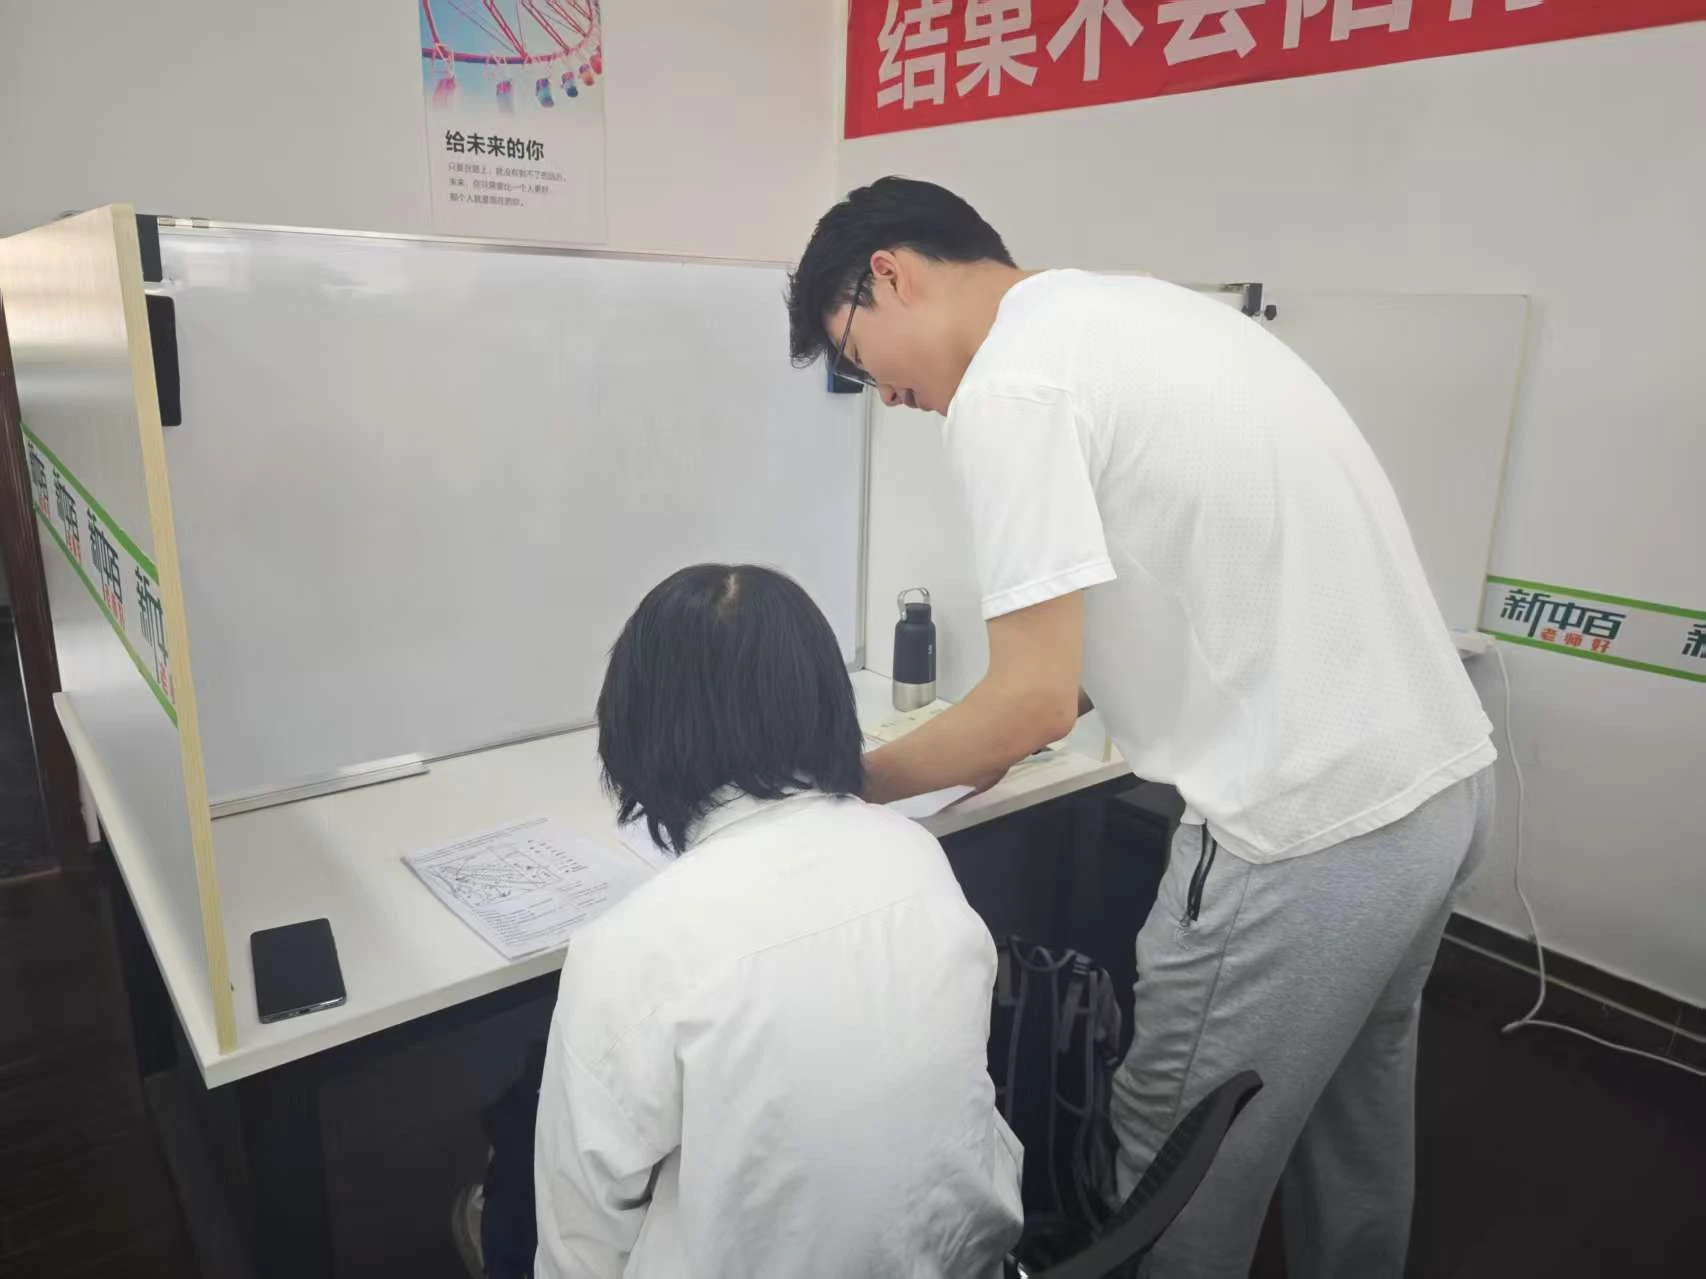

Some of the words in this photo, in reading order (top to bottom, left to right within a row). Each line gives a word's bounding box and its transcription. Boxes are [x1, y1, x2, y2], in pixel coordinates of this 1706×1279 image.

[445, 130, 545, 161] 给未来的你
[1500, 588, 1627, 640] 新中百
[1540, 627, 1613, 653] 老师好
